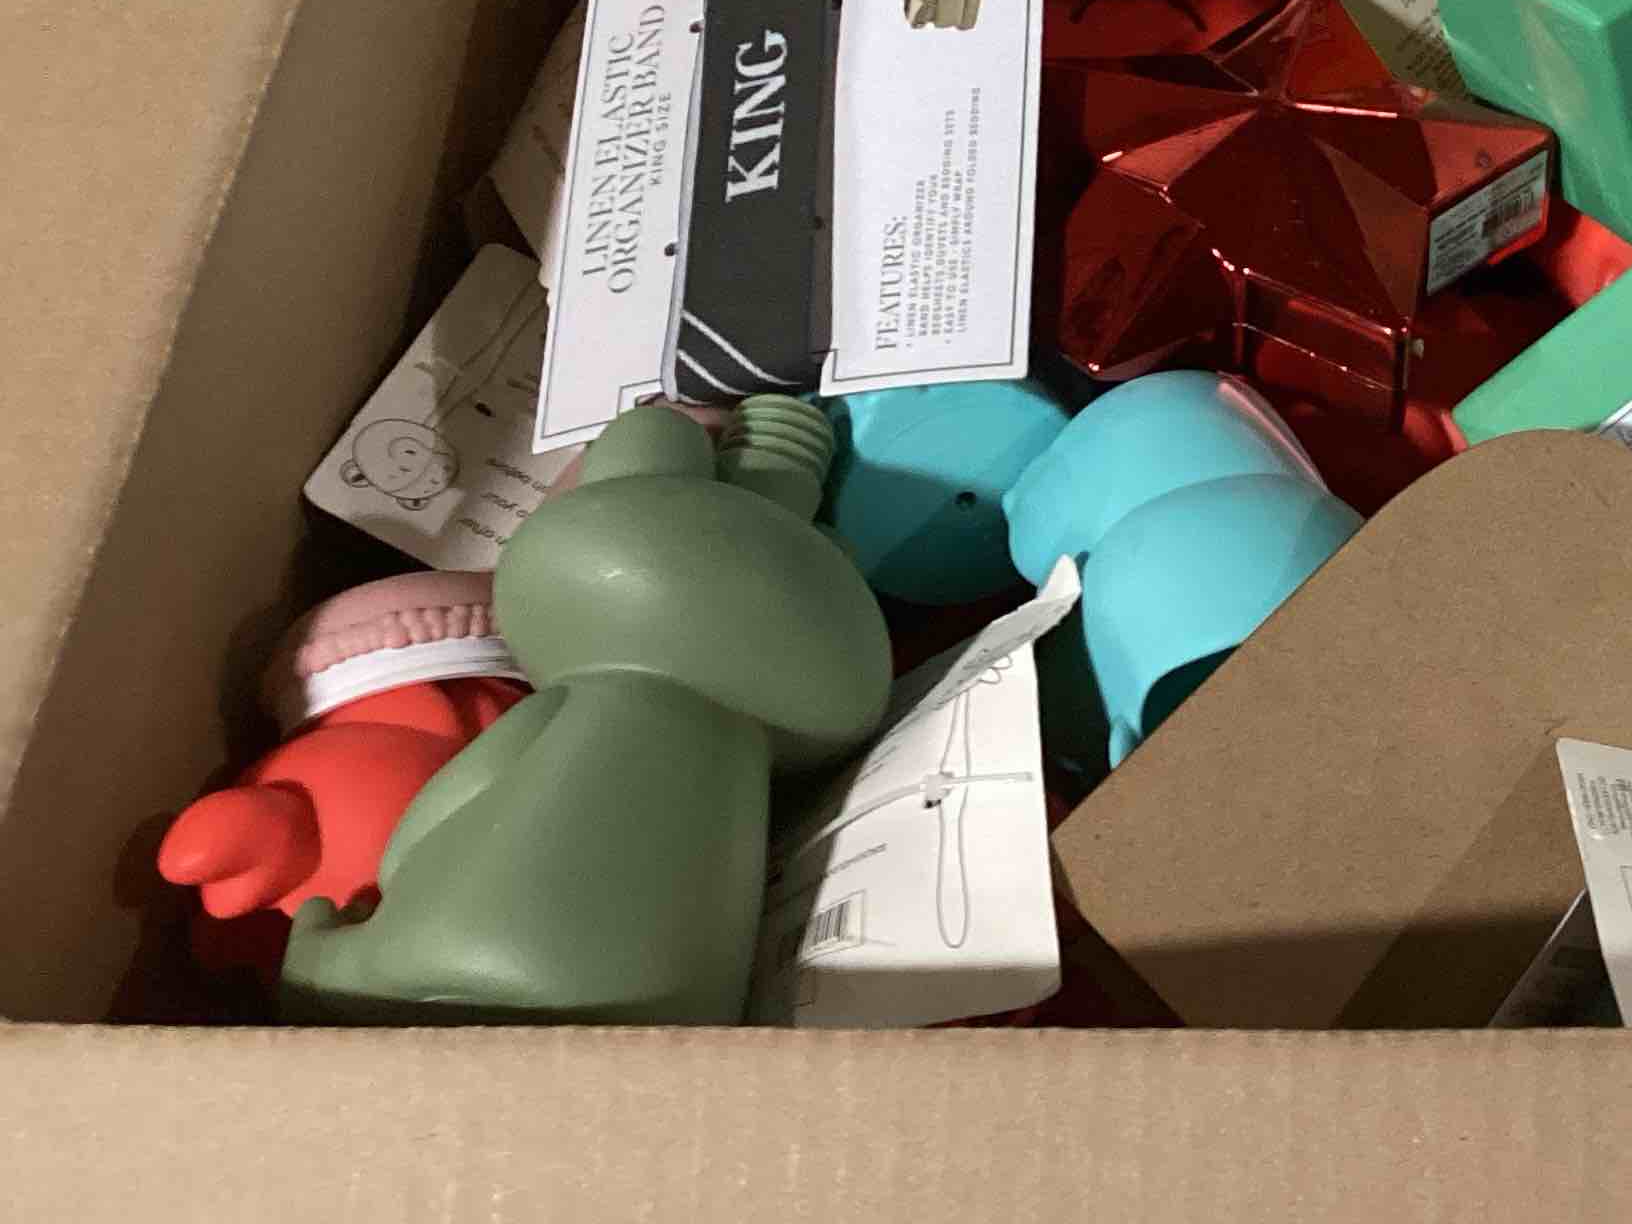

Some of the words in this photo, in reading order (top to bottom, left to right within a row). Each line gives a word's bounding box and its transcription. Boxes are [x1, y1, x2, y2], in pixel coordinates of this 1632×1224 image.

[594, 31, 635, 167] ELASTIC
[606, 95, 655, 294] ORGANIZER
[631, 3, 666, 91] BAND
[649, 137, 667, 187] KING
[655, 91, 672, 129] SIZE
[724, 27, 790, 204] KING
[582, 175, 617, 277] LINEN
[875, 214, 909, 351] FEATURES:
